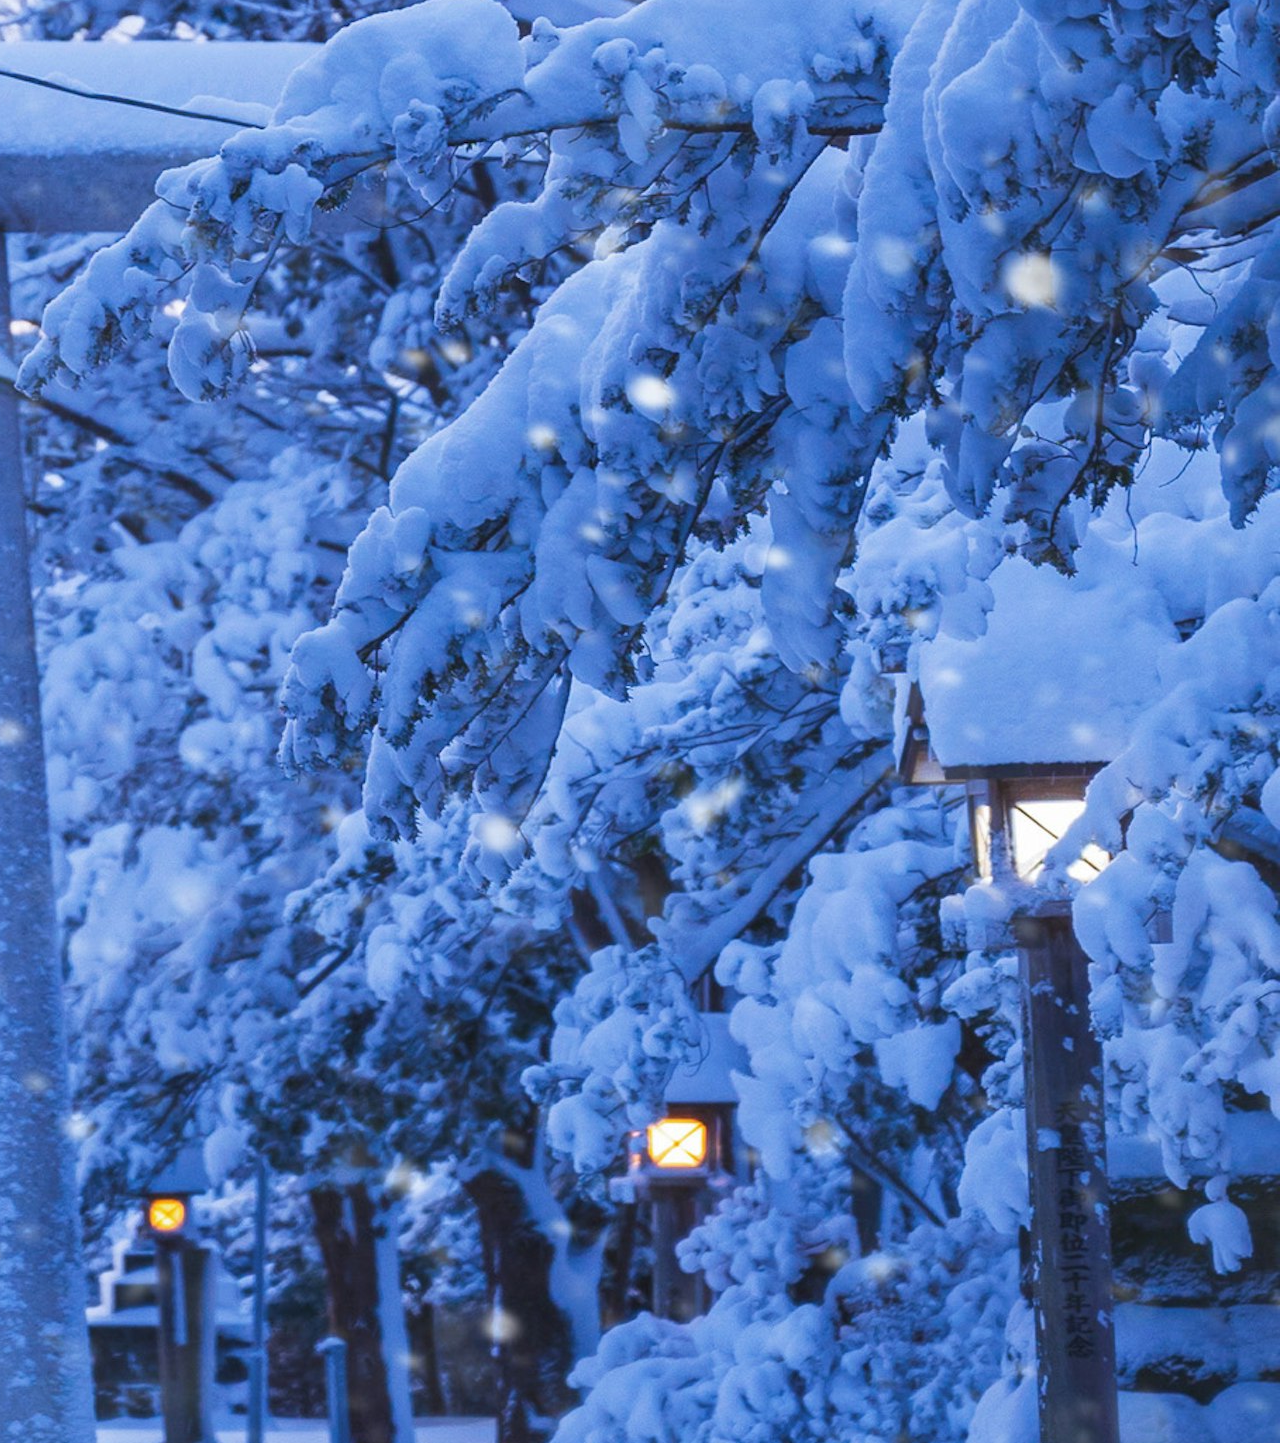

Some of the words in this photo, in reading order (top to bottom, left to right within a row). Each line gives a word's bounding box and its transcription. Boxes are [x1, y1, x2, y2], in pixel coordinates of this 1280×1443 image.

[1055, 1101, 1095, 1359] 天皇陛下御即位二十年記念
